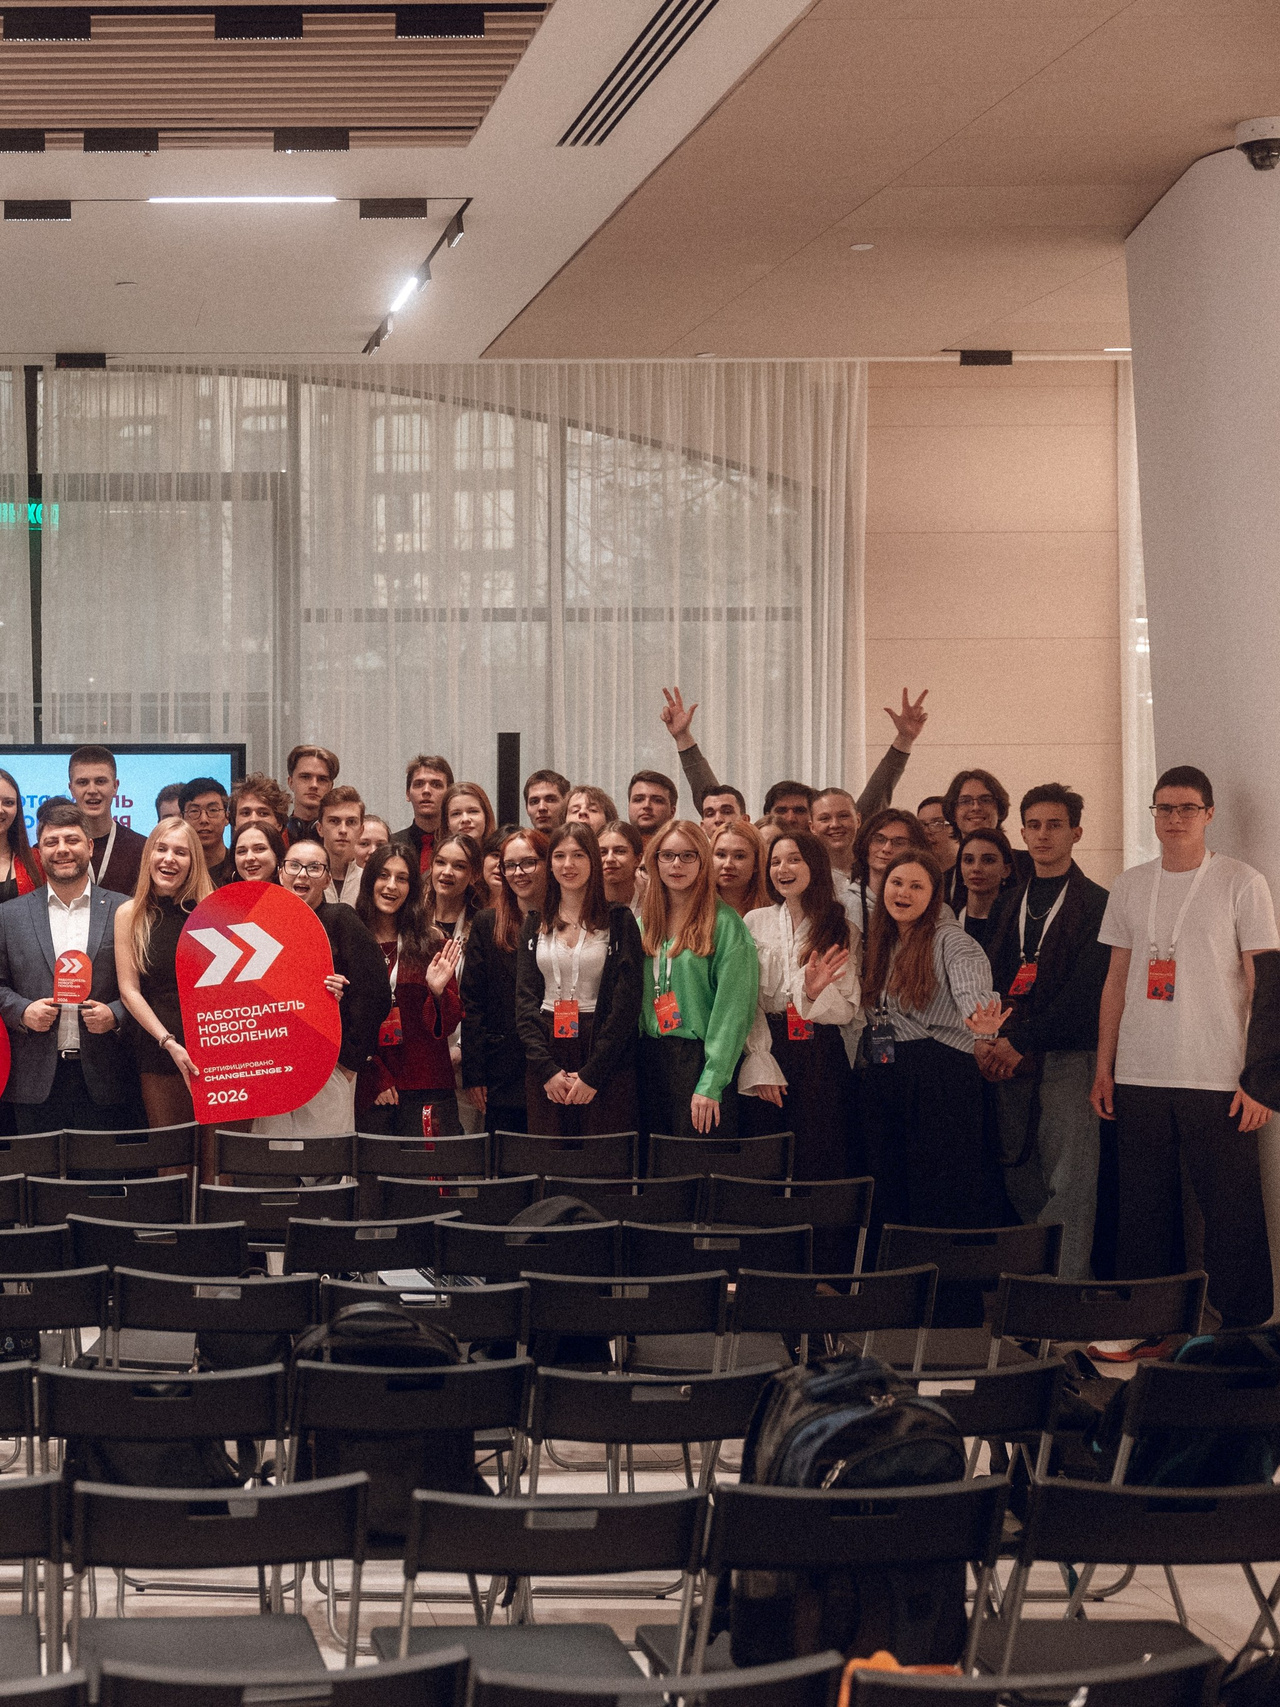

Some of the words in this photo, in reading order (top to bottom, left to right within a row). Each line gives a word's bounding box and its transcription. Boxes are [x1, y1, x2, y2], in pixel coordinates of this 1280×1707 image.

[197, 1000, 306, 1023] РАБОТОДАТЕЛЬ
[198, 1018, 257, 1035] НОВОГО
[200, 1026, 288, 1048] ПОКОЛЕНИЯ
[203, 1059, 274, 1074] СЕРТИФИЦИРОВАНО
[204, 1066, 283, 1082] CHANGELLENGE
[207, 1088, 248, 1105] 2026
